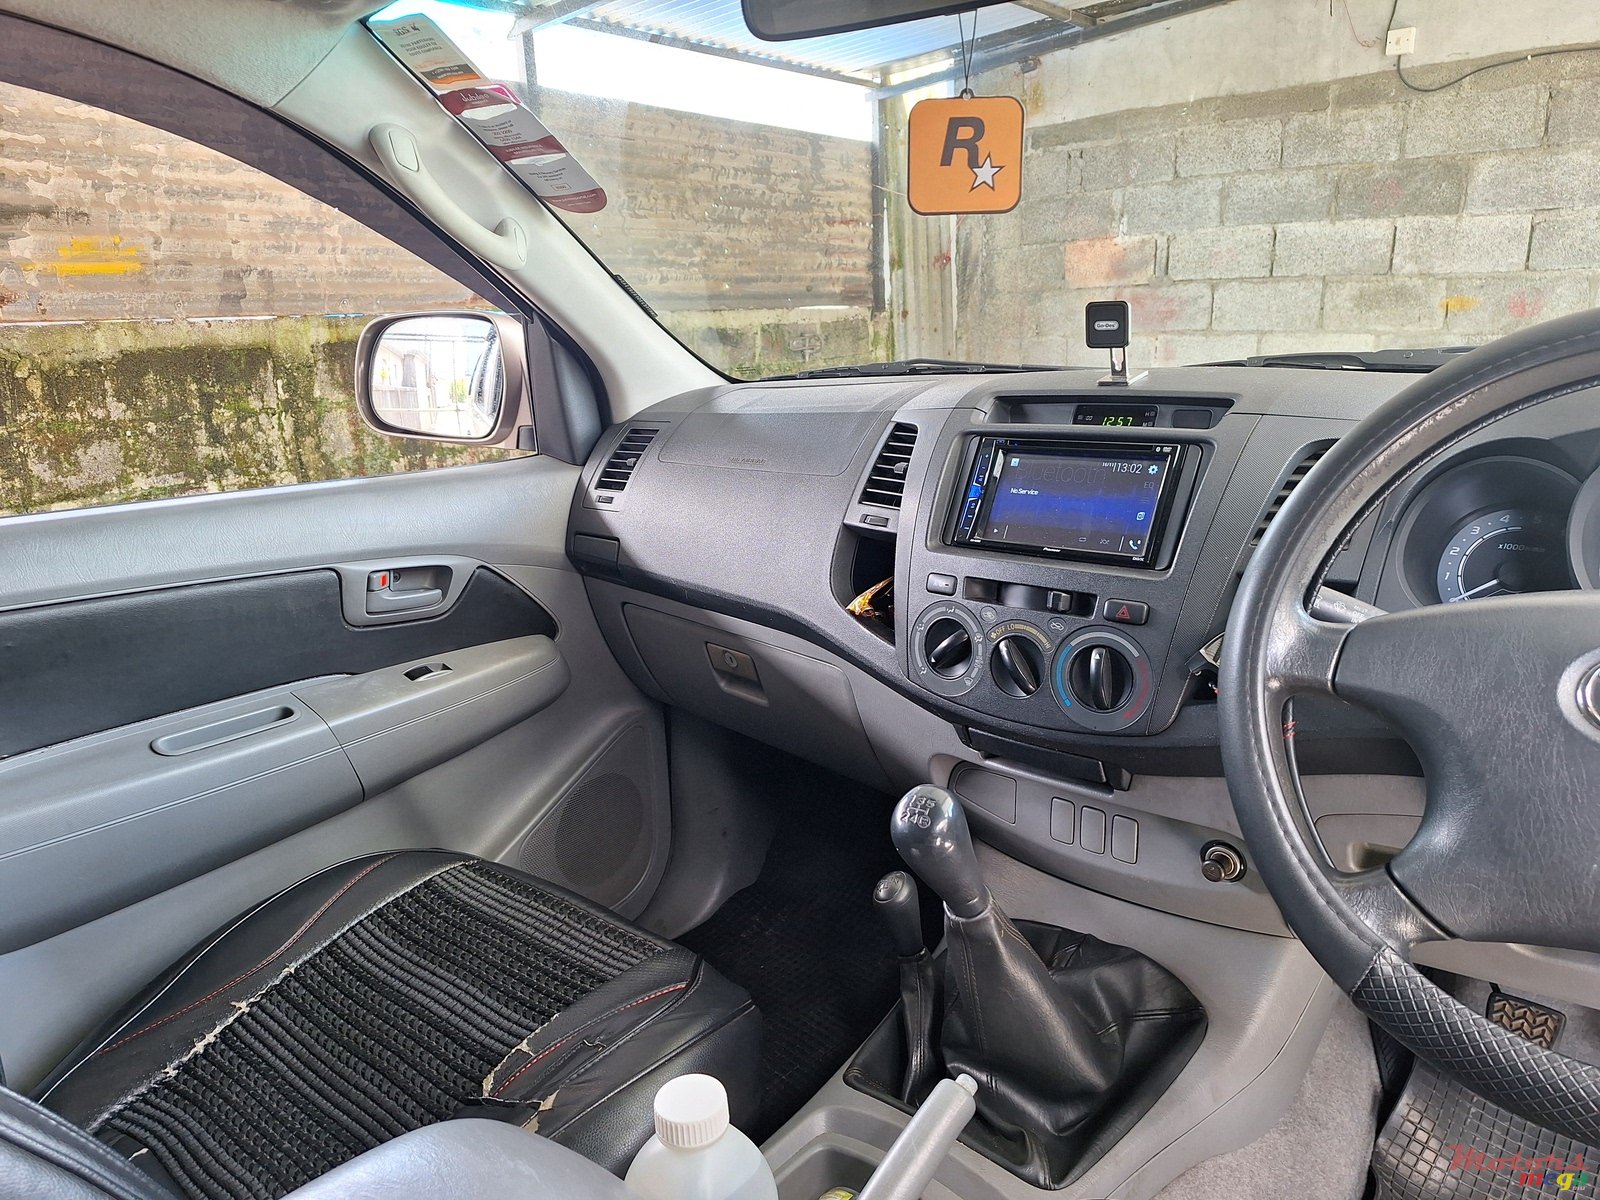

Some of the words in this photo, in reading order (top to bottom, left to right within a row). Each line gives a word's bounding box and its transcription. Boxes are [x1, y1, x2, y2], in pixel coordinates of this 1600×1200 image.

[940, 116, 986, 169] R
[1117, 463, 1143, 474] 13:02
[1500, 514, 1511, 523] 4
[1470, 526, 1481, 535] 3
[1449, 546, 1461, 556] 2
[1444, 571, 1451, 581] 1
[995, 625, 1006, 636] OFF
[1007, 623, 1015, 631] LO
